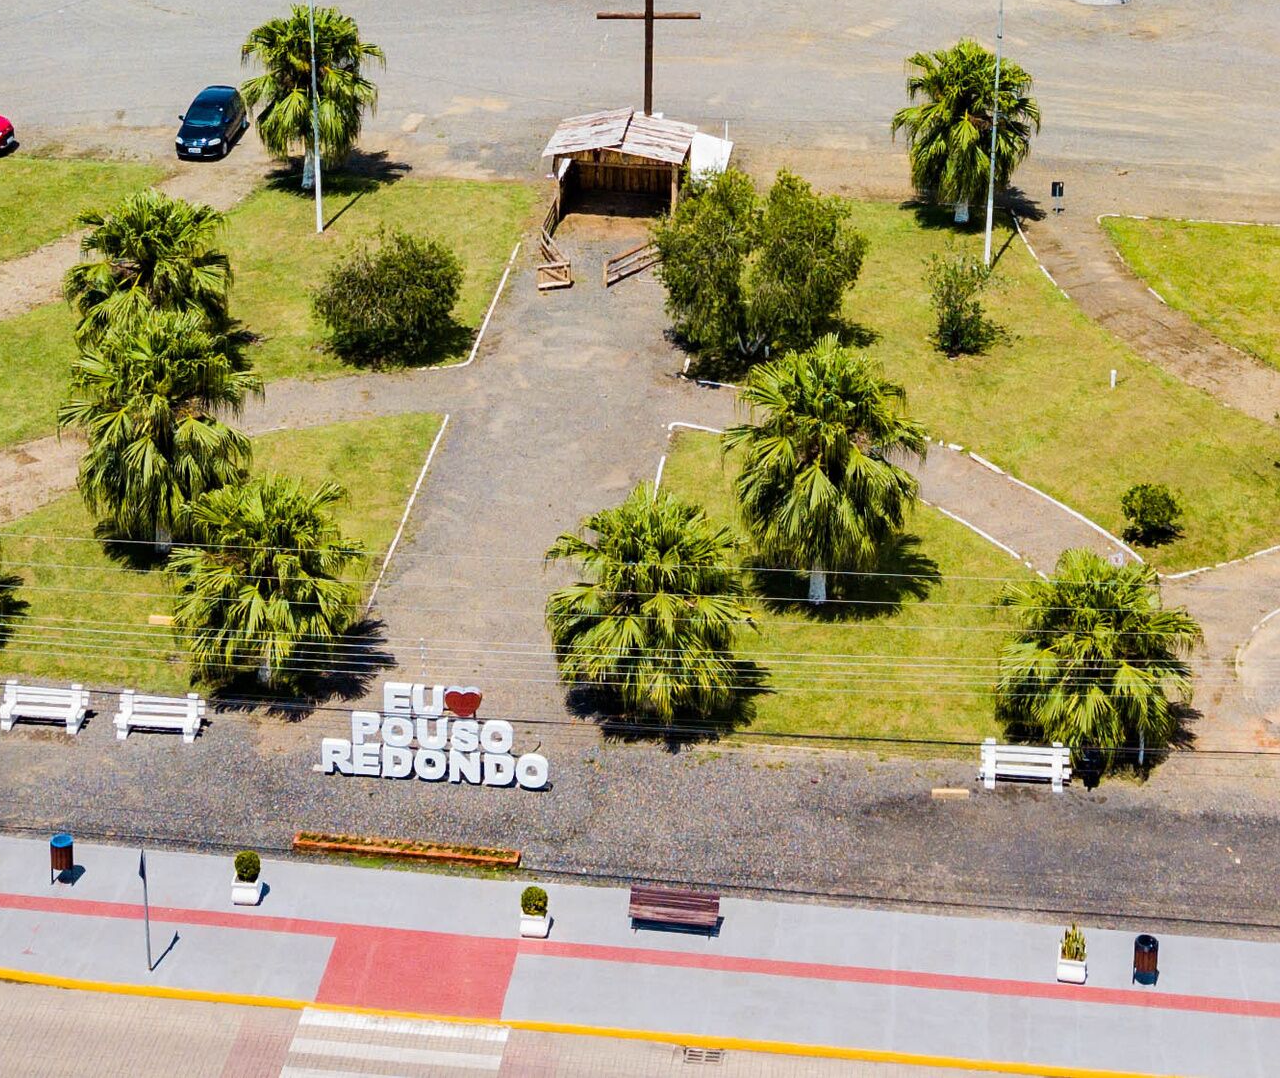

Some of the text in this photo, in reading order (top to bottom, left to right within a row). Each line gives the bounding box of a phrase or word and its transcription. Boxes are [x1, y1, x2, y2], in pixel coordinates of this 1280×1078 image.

[383, 681, 445, 719] EU
[351, 710, 514, 754] POUSO
[321, 737, 549, 789] REDONDO
